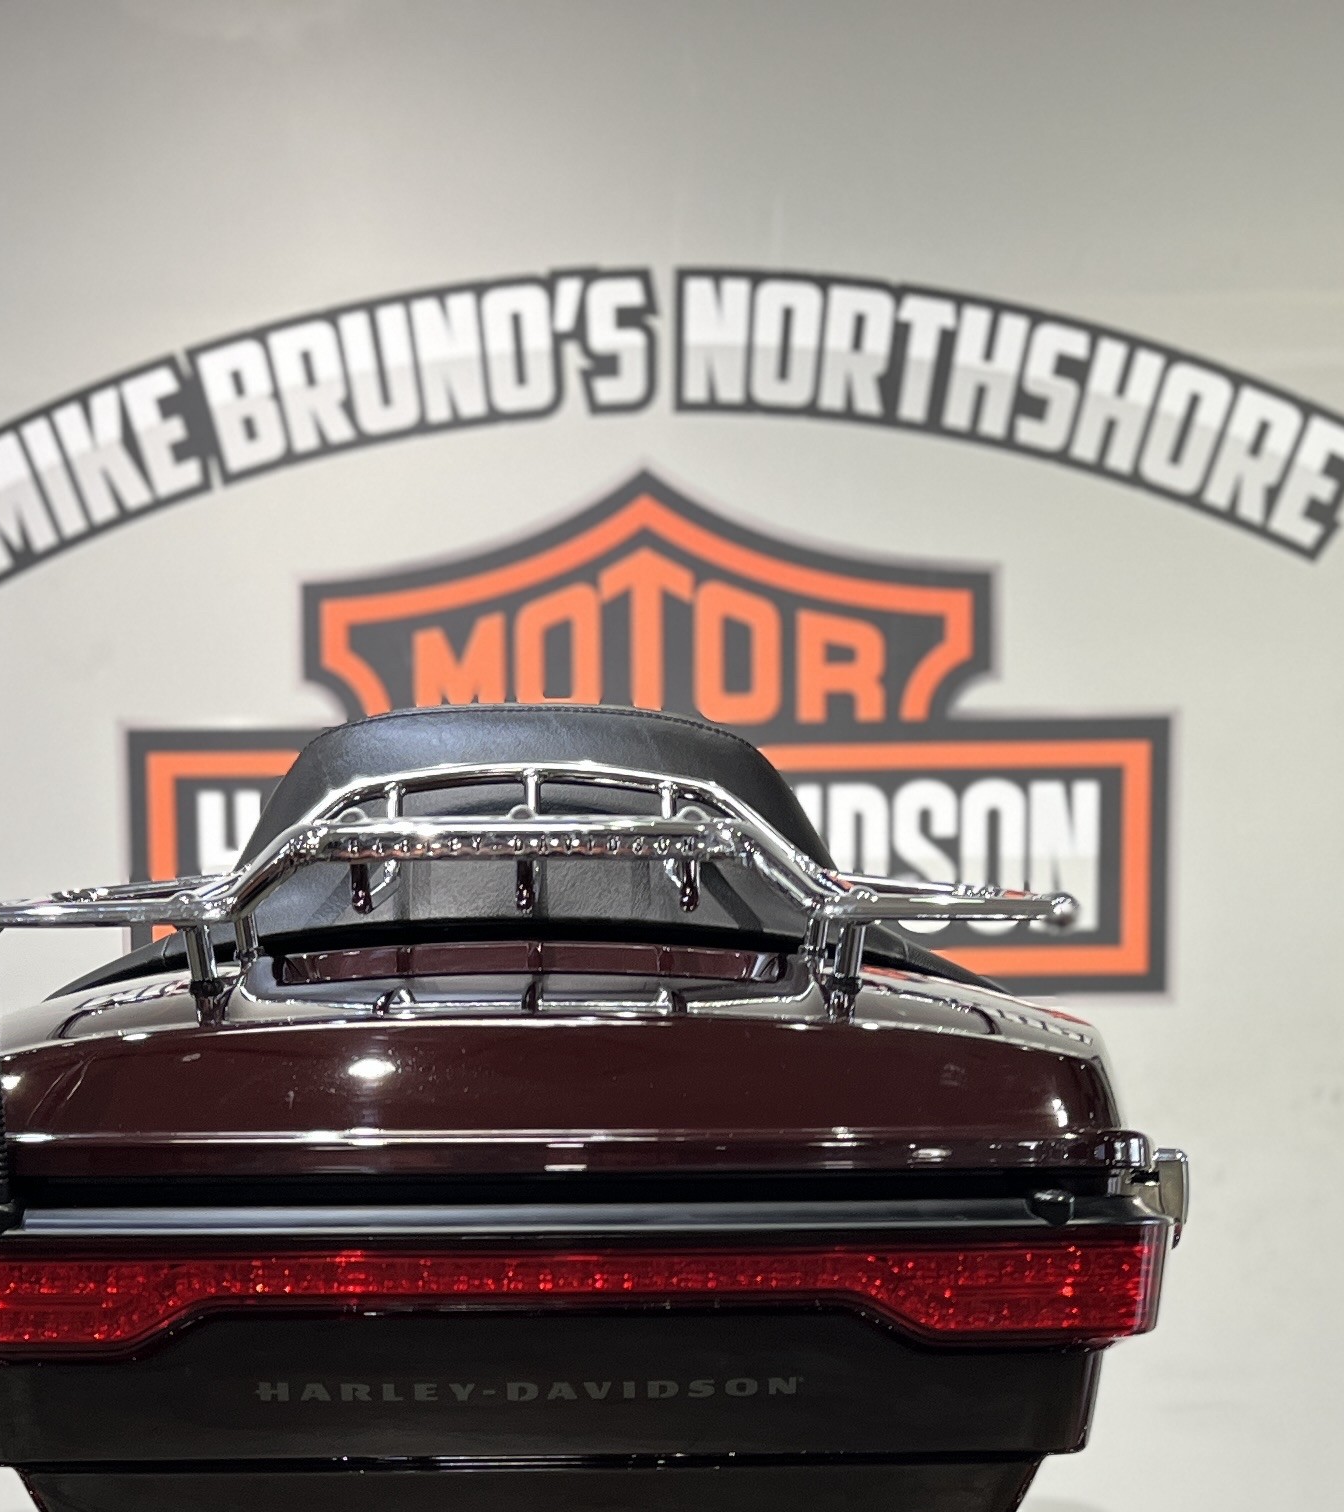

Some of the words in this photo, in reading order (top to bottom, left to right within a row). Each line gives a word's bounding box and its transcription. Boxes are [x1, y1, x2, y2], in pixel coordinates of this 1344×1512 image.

[193, 274, 652, 478] BRUNO'S
[410, 546, 887, 725] MOTOR
[256, 1376, 800, 1402] HARLEY-DAVIDSON
